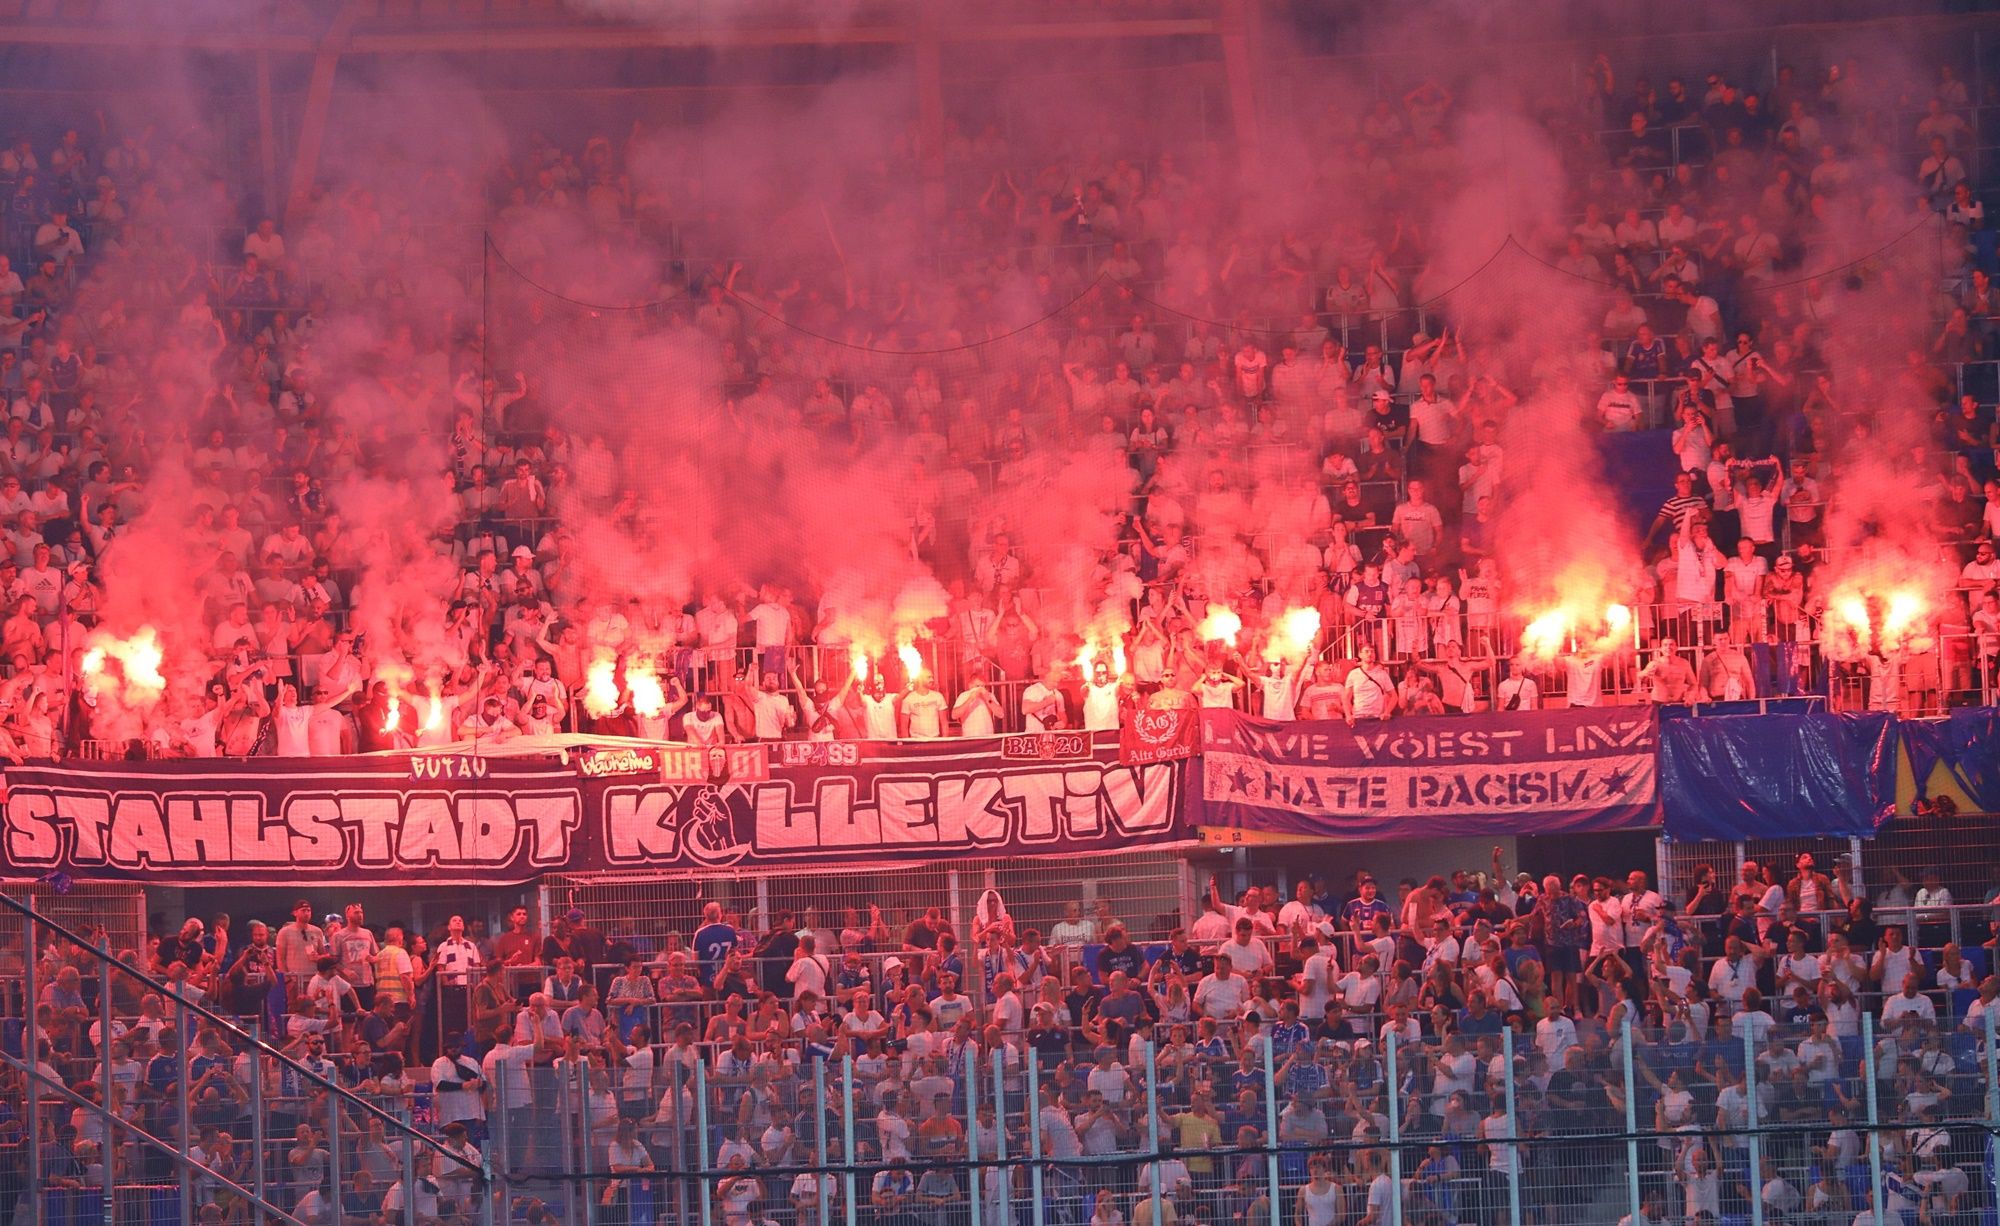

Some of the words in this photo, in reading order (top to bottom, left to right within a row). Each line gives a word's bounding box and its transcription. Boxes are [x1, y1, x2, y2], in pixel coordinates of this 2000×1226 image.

[1145, 715, 1170, 731] AG
[783, 740, 812, 765] LP
[1007, 736, 1039, 755] BA
[1055, 736, 1084, 754] 20
[1204, 719, 1329, 761] LOVE
[1546, 719, 1653, 754] LINZ
[664, 751, 703, 780] UR
[1128, 749, 1154, 763] Alte
[1155, 743, 1191, 760] Garde
[1264, 770, 1388, 809] HATE
[1408, 768, 1592, 808] RACISM
[5, 787, 580, 867] STAHLSTADT
[708, 941, 733, 962] 27
